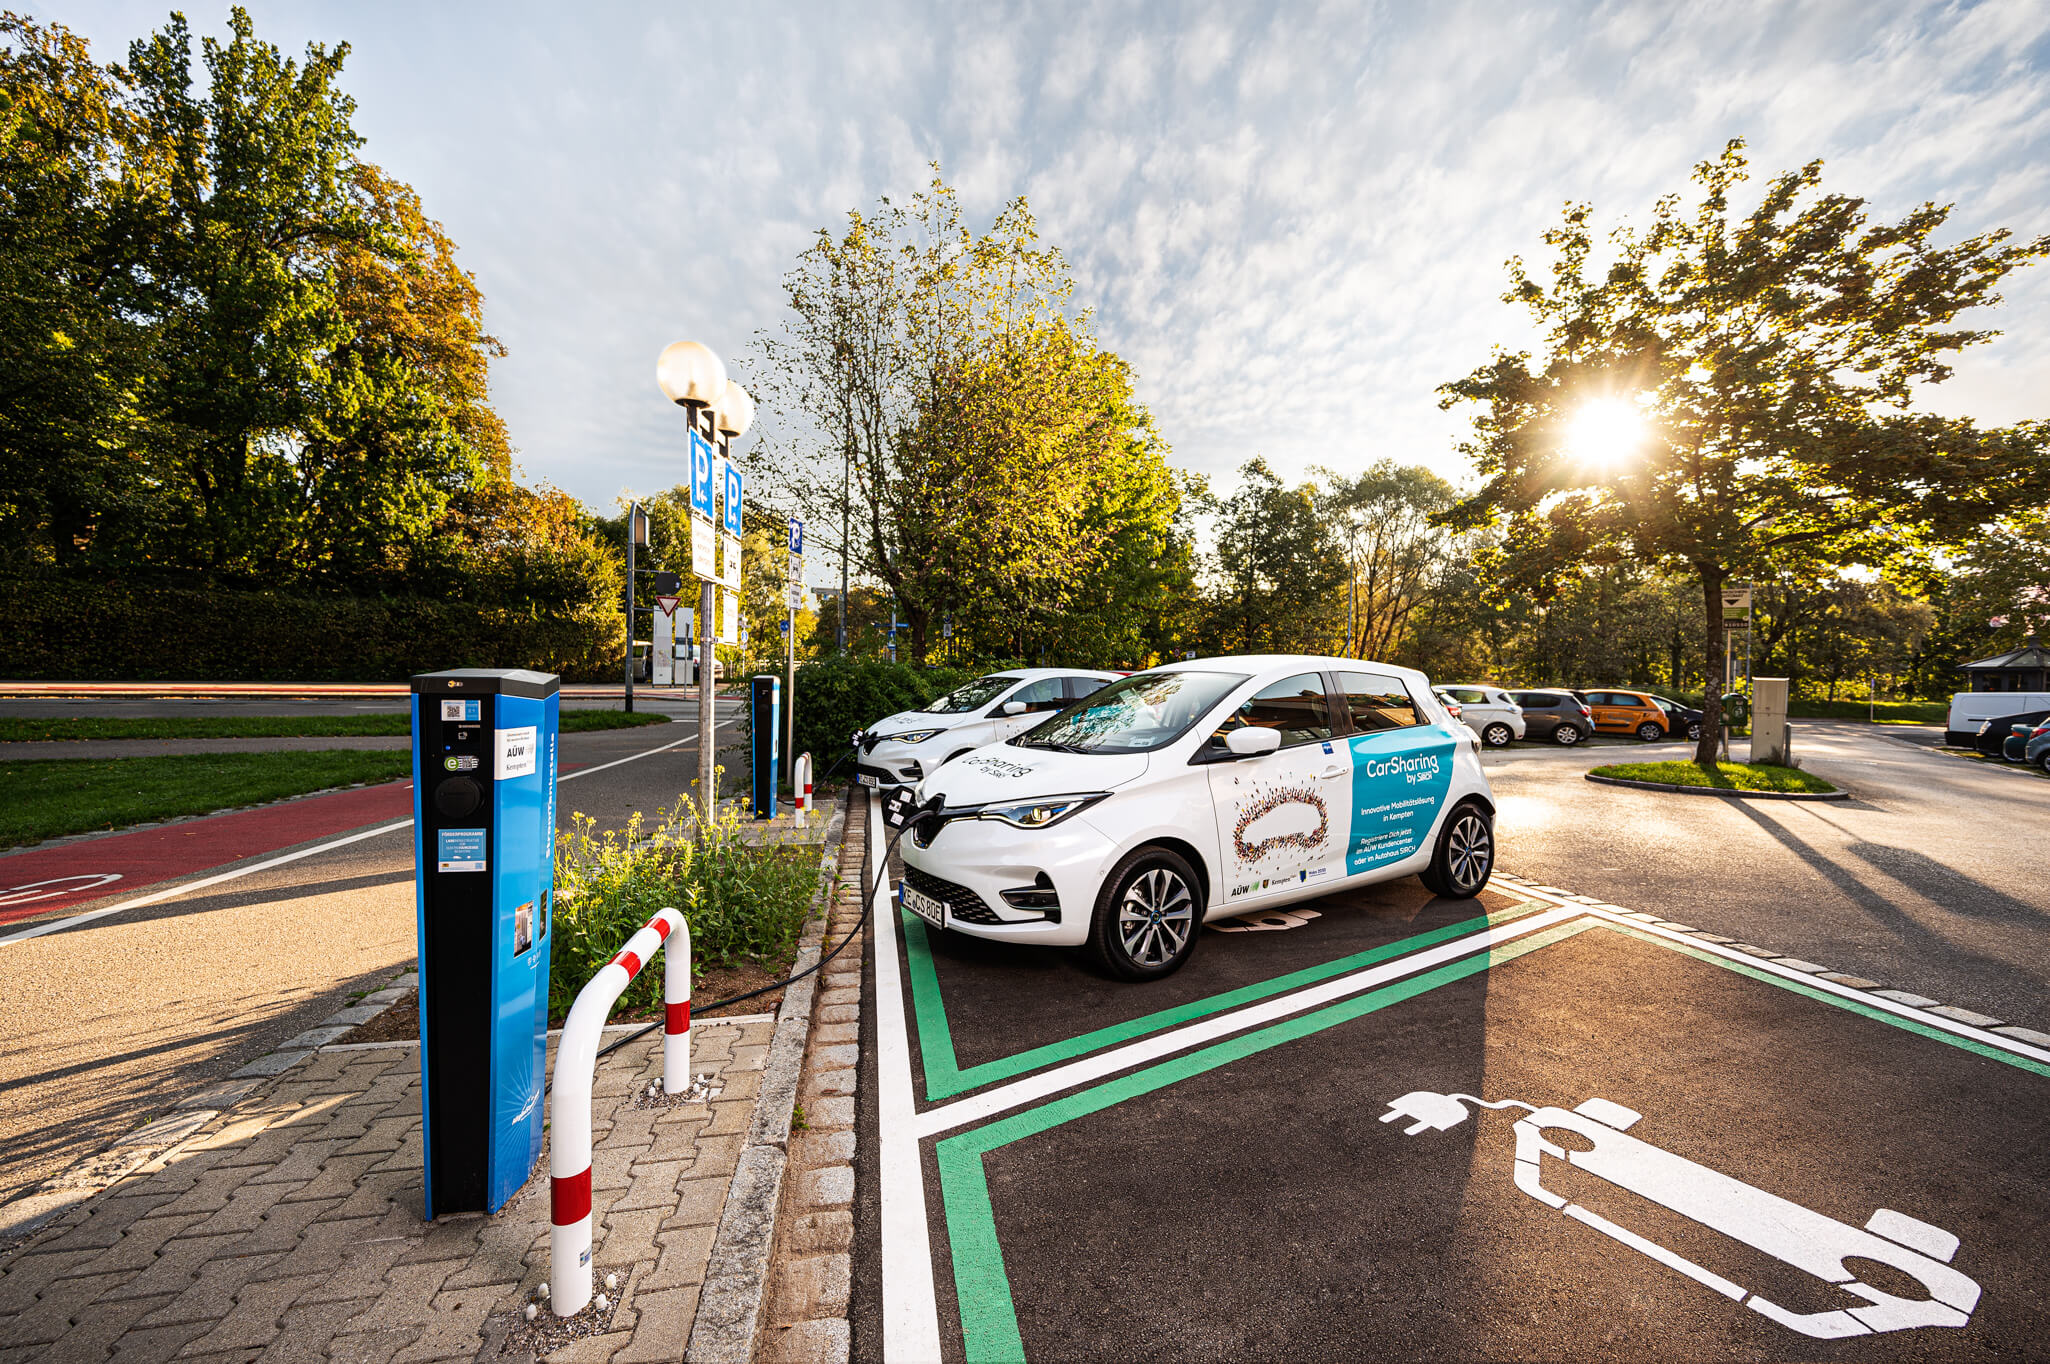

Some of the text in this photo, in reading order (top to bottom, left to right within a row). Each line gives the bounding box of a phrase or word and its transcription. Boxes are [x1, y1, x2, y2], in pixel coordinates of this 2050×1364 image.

[695, 442, 708, 501] P
[728, 471, 739, 523] P
[506, 745, 525, 758] AÜW
[1367, 753, 1439, 777] CarSharing
[1407, 773, 1416, 785] by
[1361, 796, 1435, 815] Innovative Mobilitätslösung
[1389, 810, 1414, 820] Kempten
[1360, 834, 1388, 846] Registriere
[1377, 837, 1413, 850] Kundencenter
[1354, 857, 1367, 866] oder
[1367, 854, 1375, 863] im
[1375, 850, 1400, 861] Autohaus
[1231, 884, 1250, 897] AÜW
[904, 888, 911, 906] KE
[916, 895, 925, 913] CS
